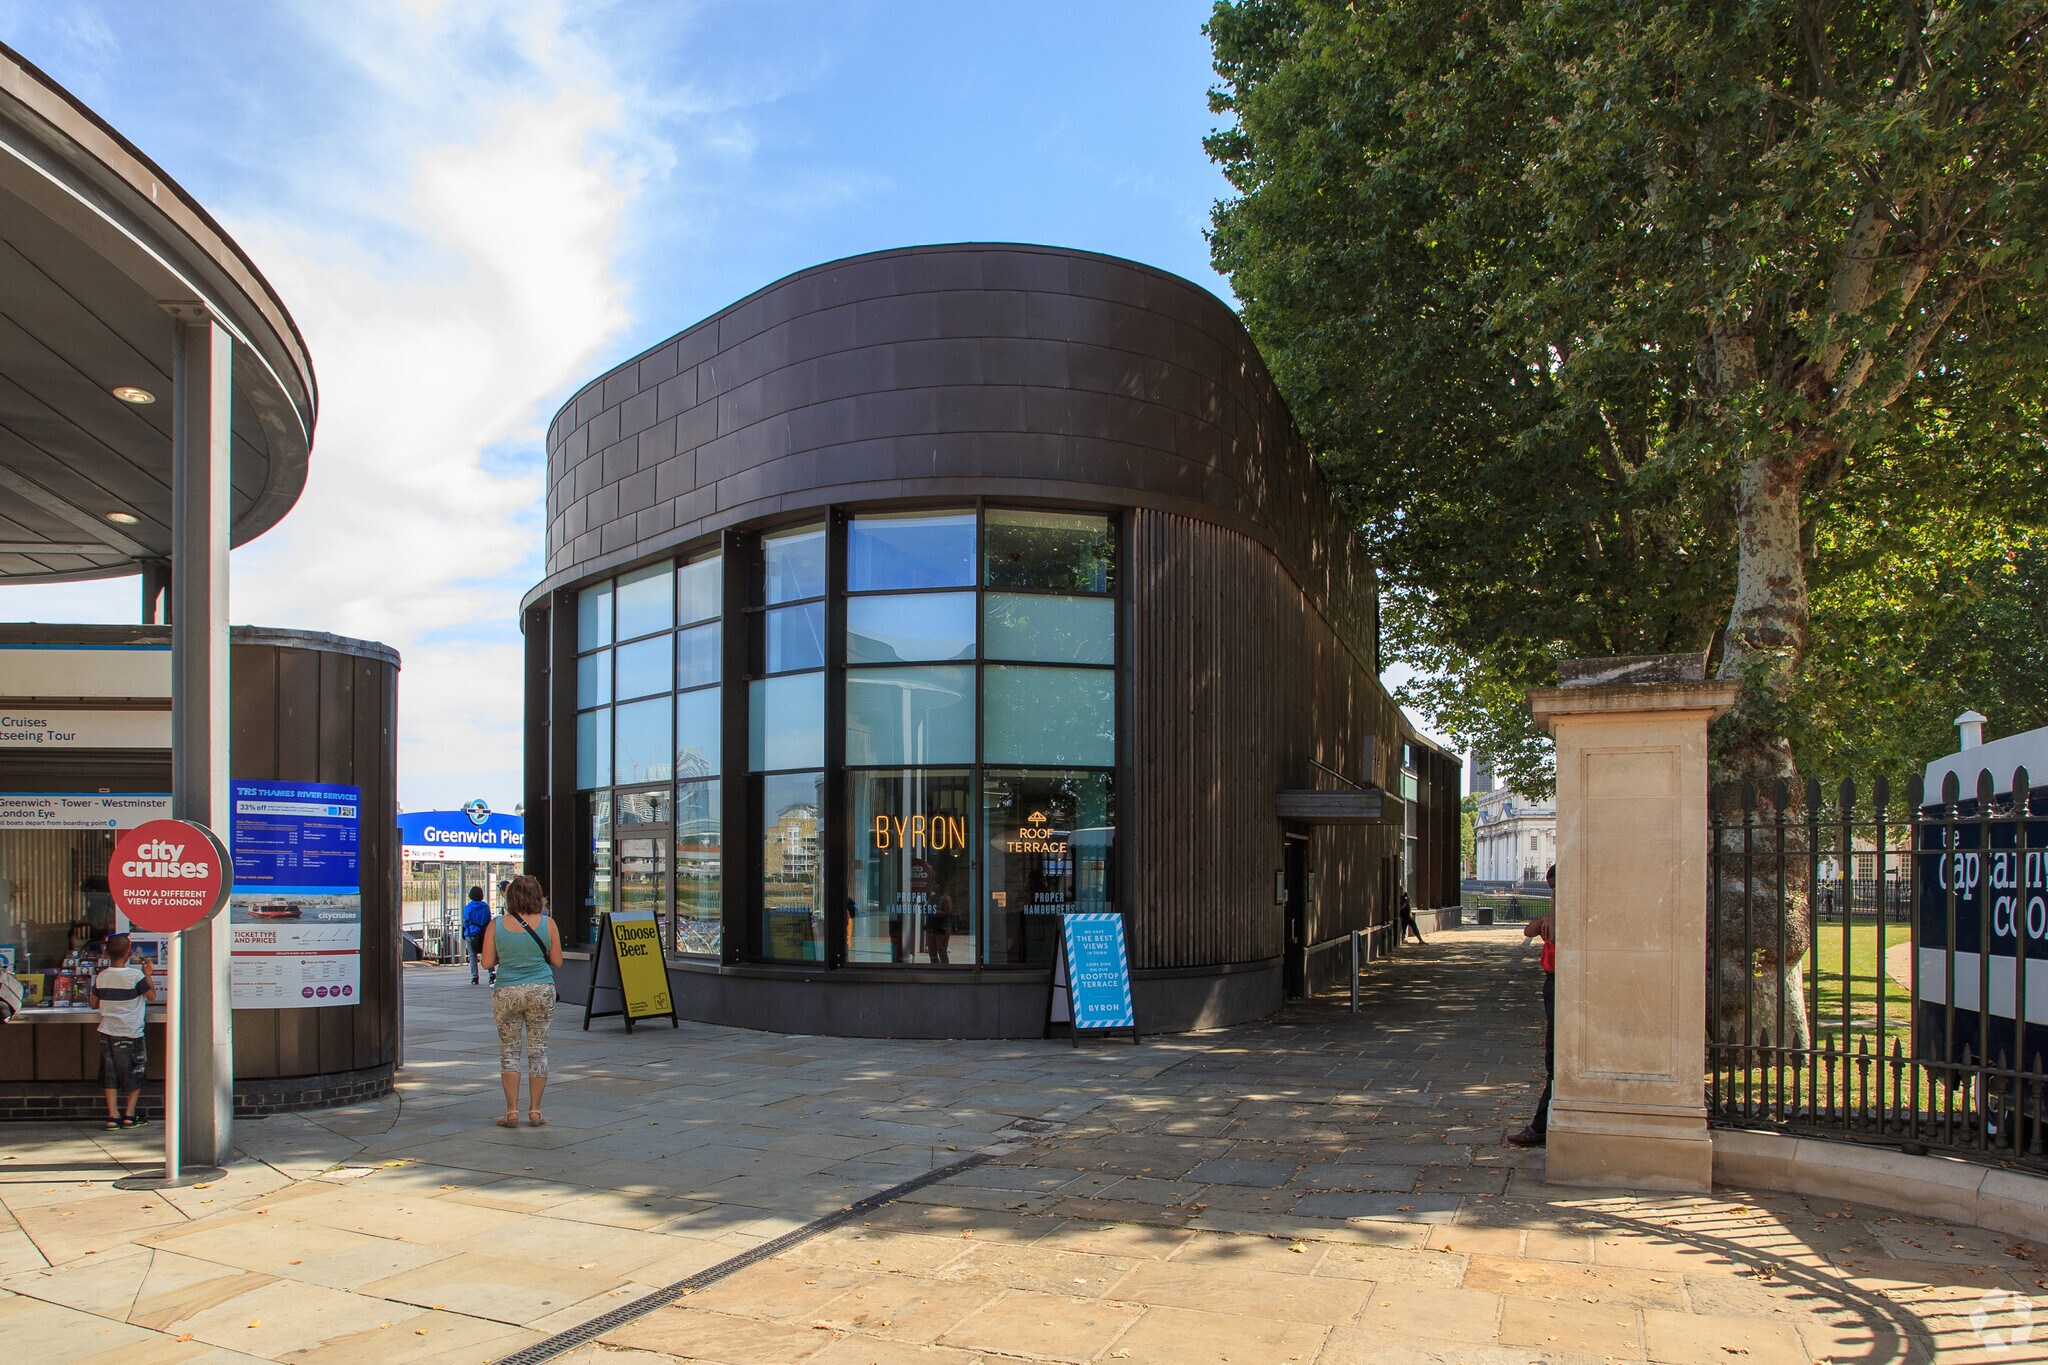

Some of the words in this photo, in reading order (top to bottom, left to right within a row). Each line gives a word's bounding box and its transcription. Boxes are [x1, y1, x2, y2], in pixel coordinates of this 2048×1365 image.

[2, 717, 47, 727] Cruises
[47, 731, 76, 741] Tour
[237, 788, 257, 796] TRS
[258, 789, 295, 797] THAMES
[323, 792, 357, 800] SERVICES
[61, 799, 91, 807] Tower
[101, 799, 166, 807] Westminster
[38, 809, 55, 819] Eye
[424, 827, 496, 844] Greenwich
[501, 829, 524, 845] Pier
[876, 815, 965, 849] BYRON
[1019, 827, 1054, 839] ROOF
[1941, 827, 1960, 848] te
[137, 839, 185, 862] city
[1006, 841, 1067, 853] TERRACE
[122, 861, 209, 879] cruises
[123, 889, 152, 897] ENJOY
[160, 890, 207, 898] DIFFERENT
[897, 892, 927, 902] PROPER
[1034, 893, 1065, 902] PROPER
[127, 898, 149, 906] VIEW
[164, 899, 203, 907] LONDON
[886, 904, 938, 914] HAMBURGERS
[1023, 905, 1076, 915] HAMBURGERS
[318, 911, 356, 920] citycruises
[615, 925, 656, 941] Choose
[619, 942, 648, 957] Beer.
[1088, 1004, 1119, 1012] BYRON
